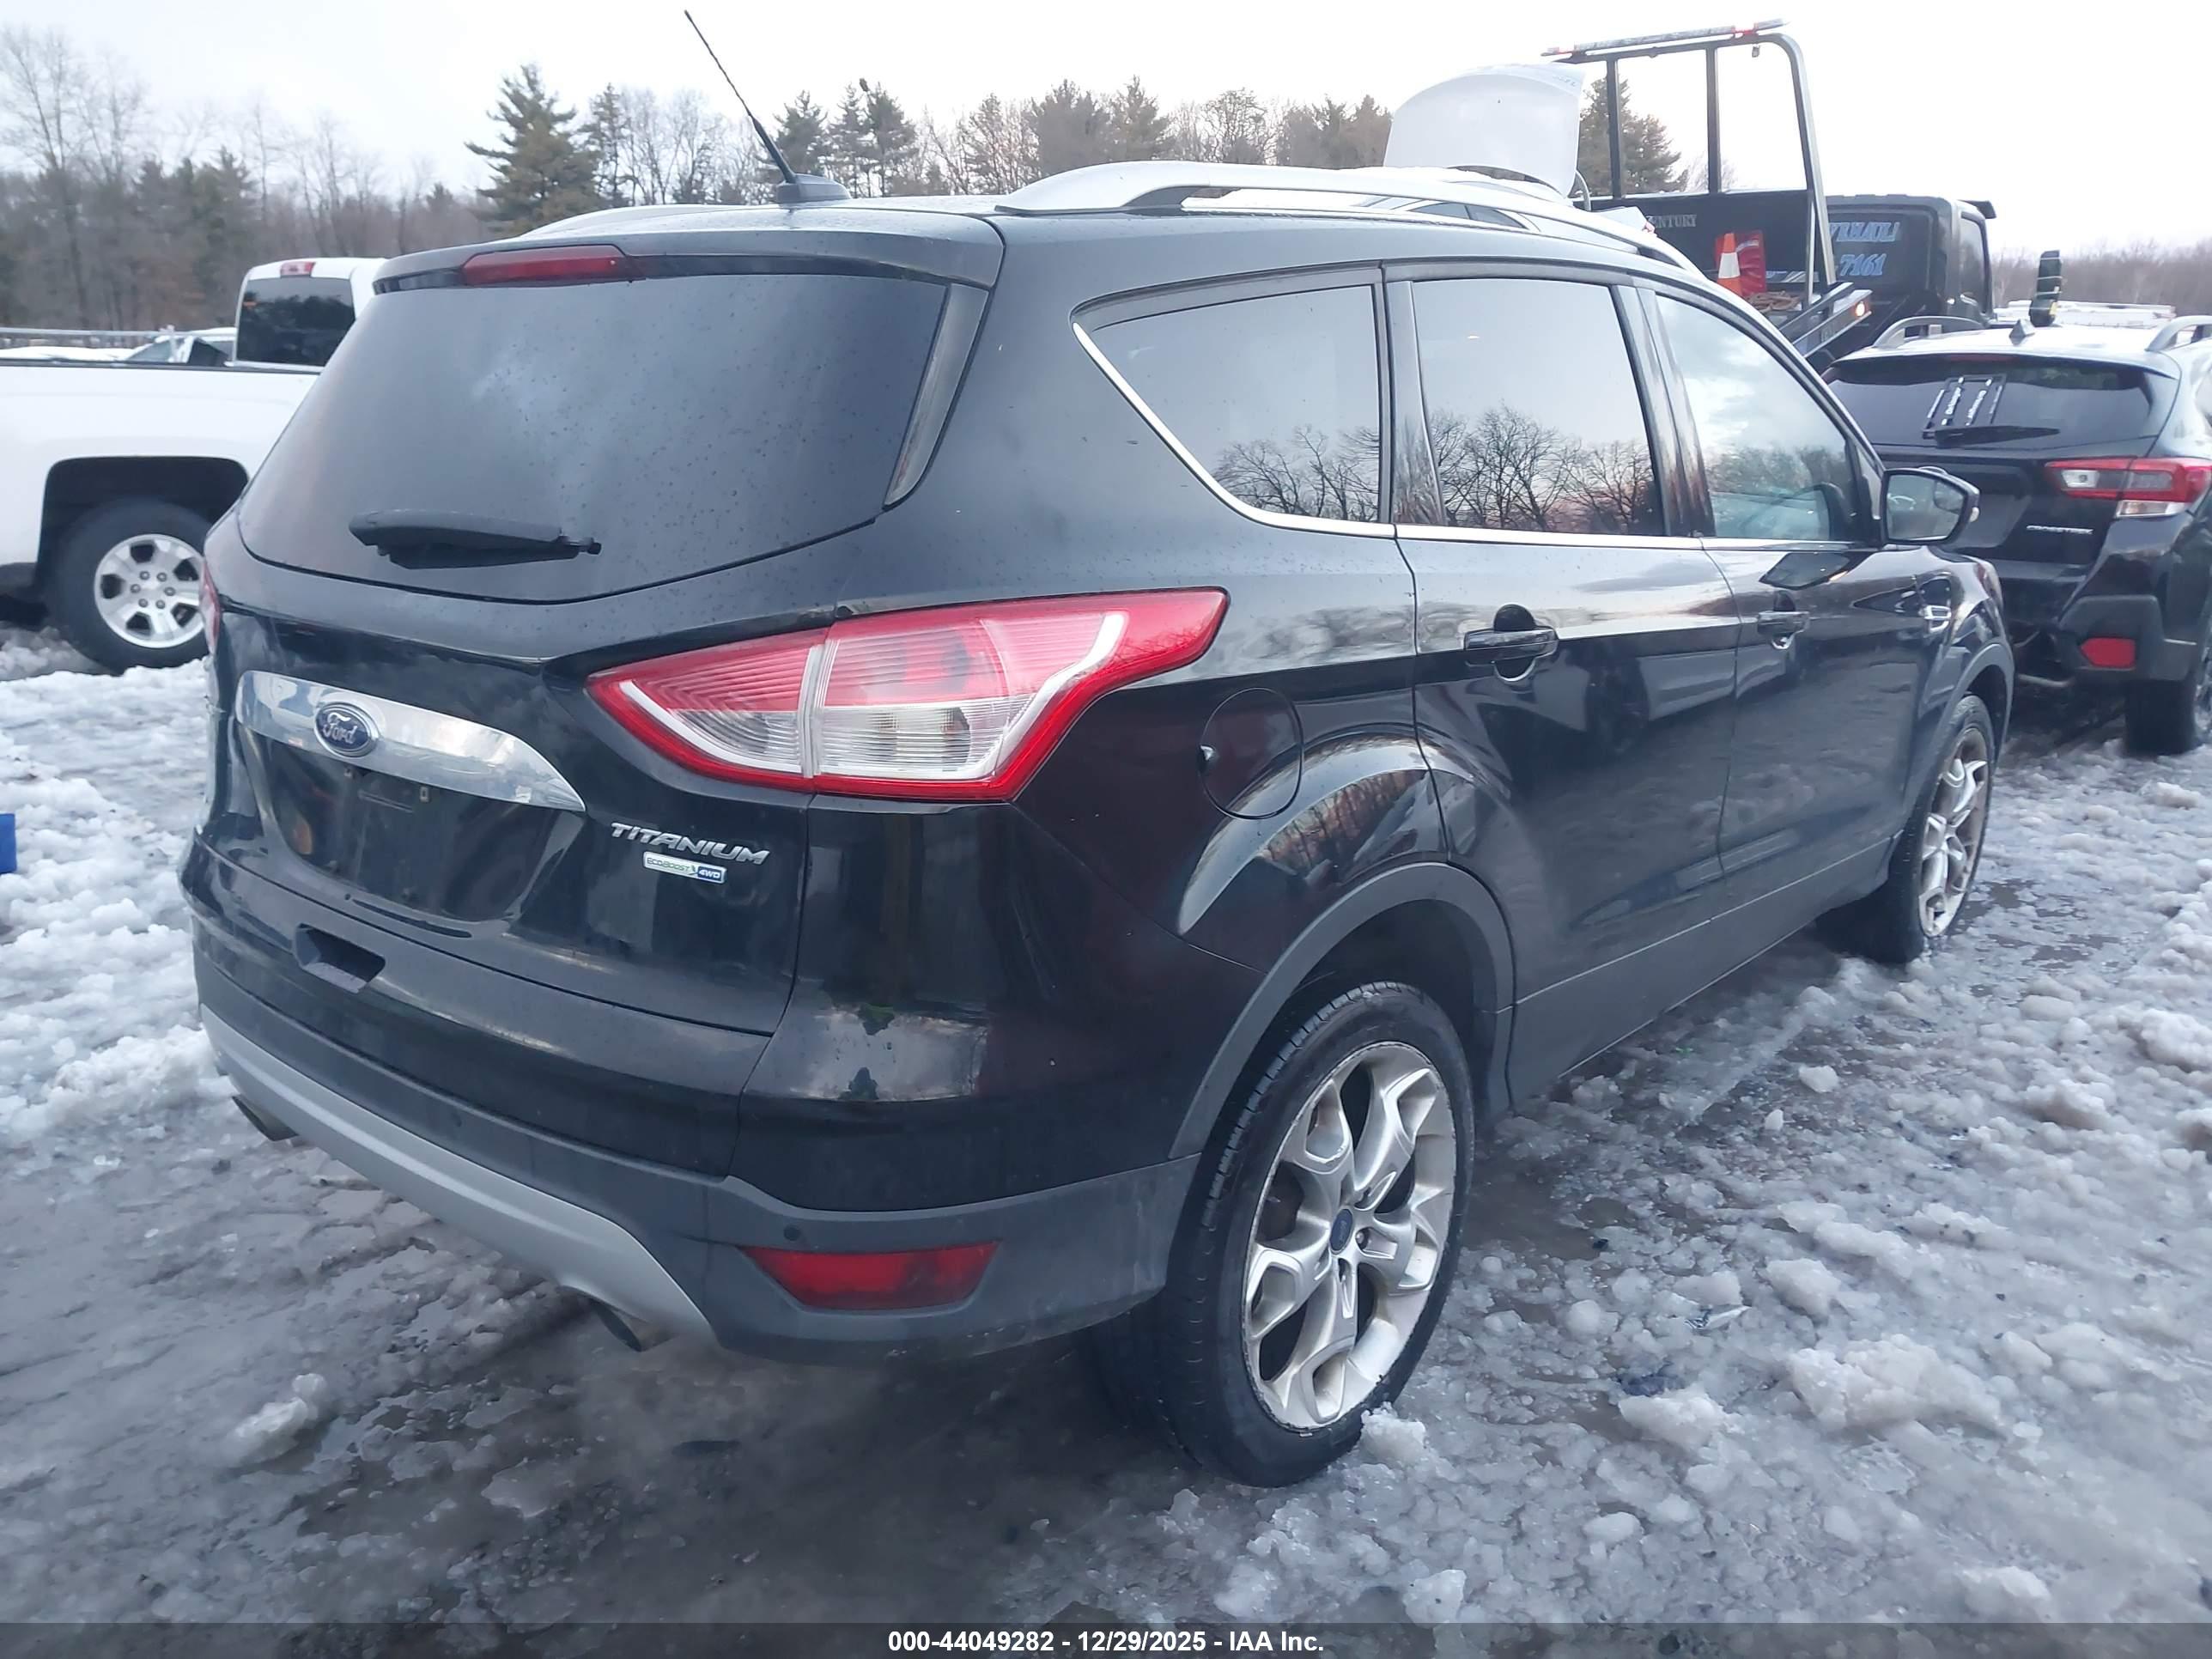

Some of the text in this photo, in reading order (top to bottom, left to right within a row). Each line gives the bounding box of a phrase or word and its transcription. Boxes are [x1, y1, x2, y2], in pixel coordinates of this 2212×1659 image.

[1647, 214, 1698, 228] ENTURY
[322, 712, 358, 744] Ford
[611, 822, 770, 865] TITANIUM
[698, 868, 721, 878] 4WD
